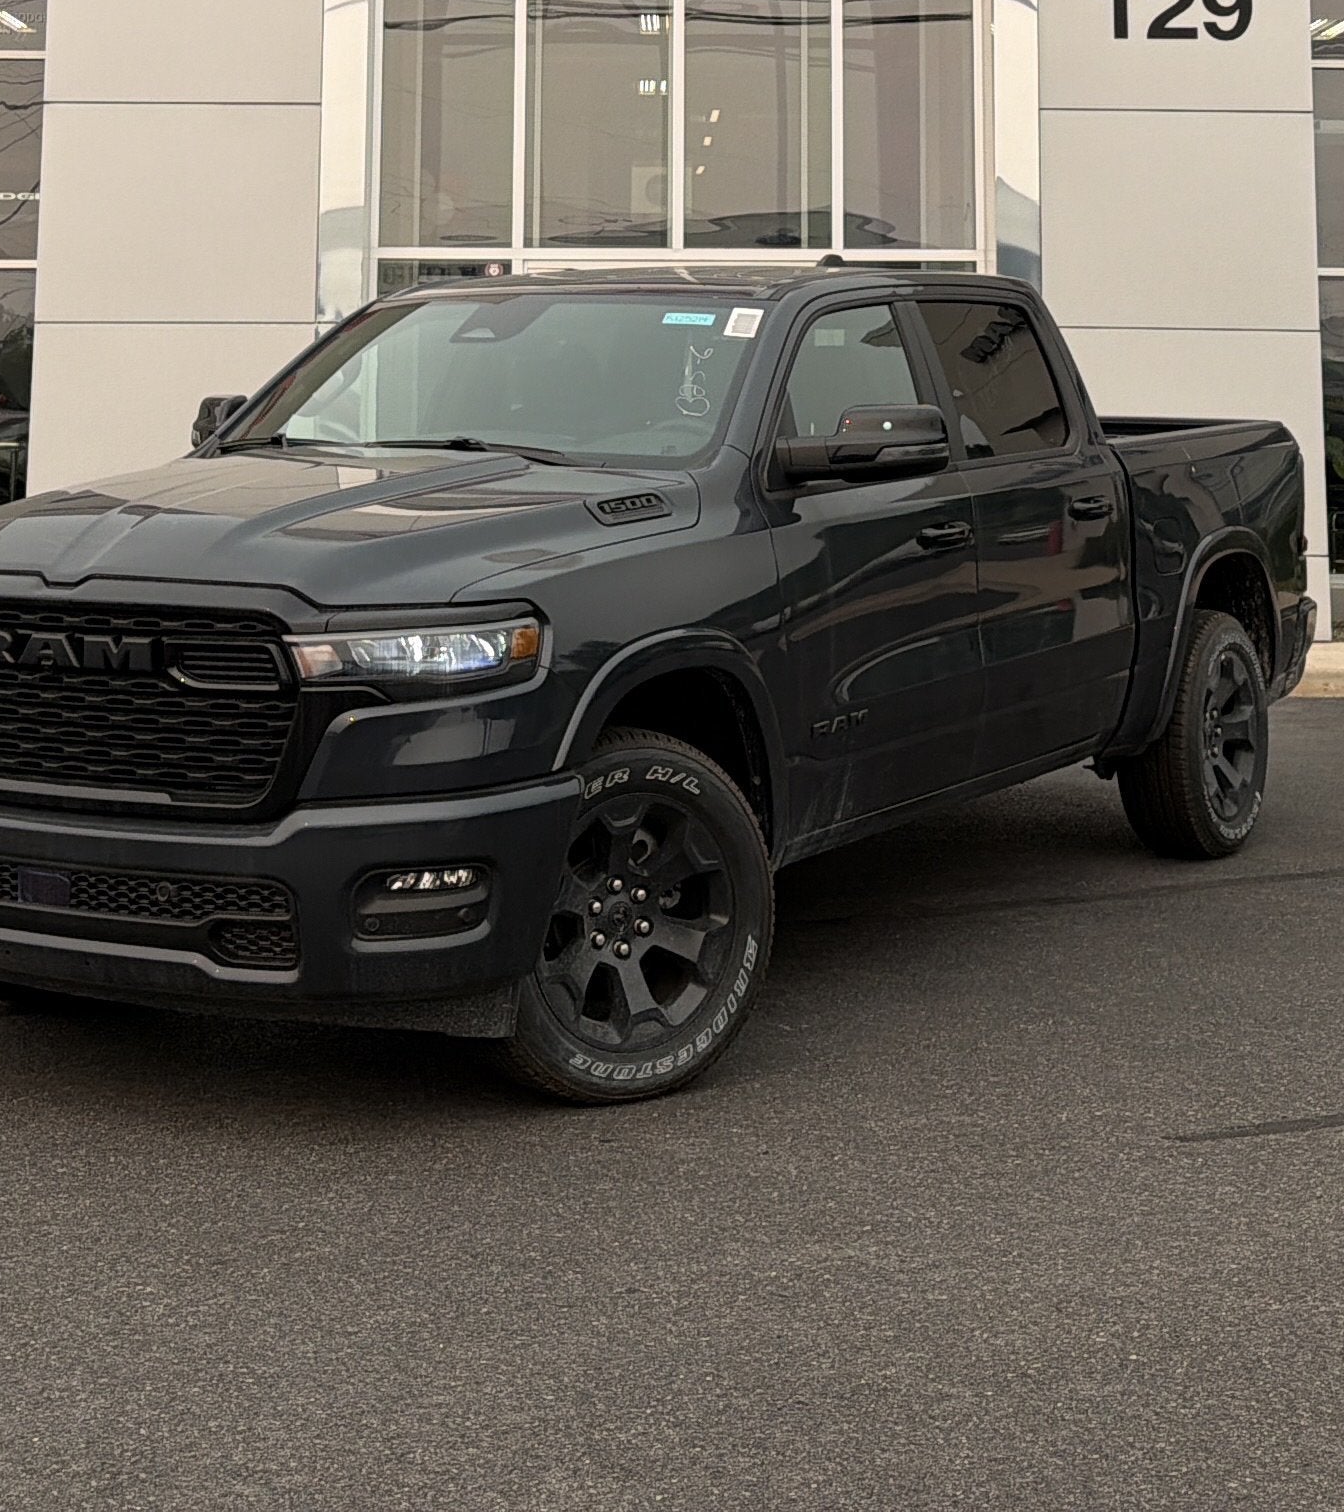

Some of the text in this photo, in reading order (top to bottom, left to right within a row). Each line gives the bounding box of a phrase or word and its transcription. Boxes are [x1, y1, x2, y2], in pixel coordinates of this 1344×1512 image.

[598, 495, 658, 514] 1500
[810, 708, 870, 739] RAM
[645, 764, 701, 796] H/L
[569, 932, 759, 1080] BRIDGESTONE
